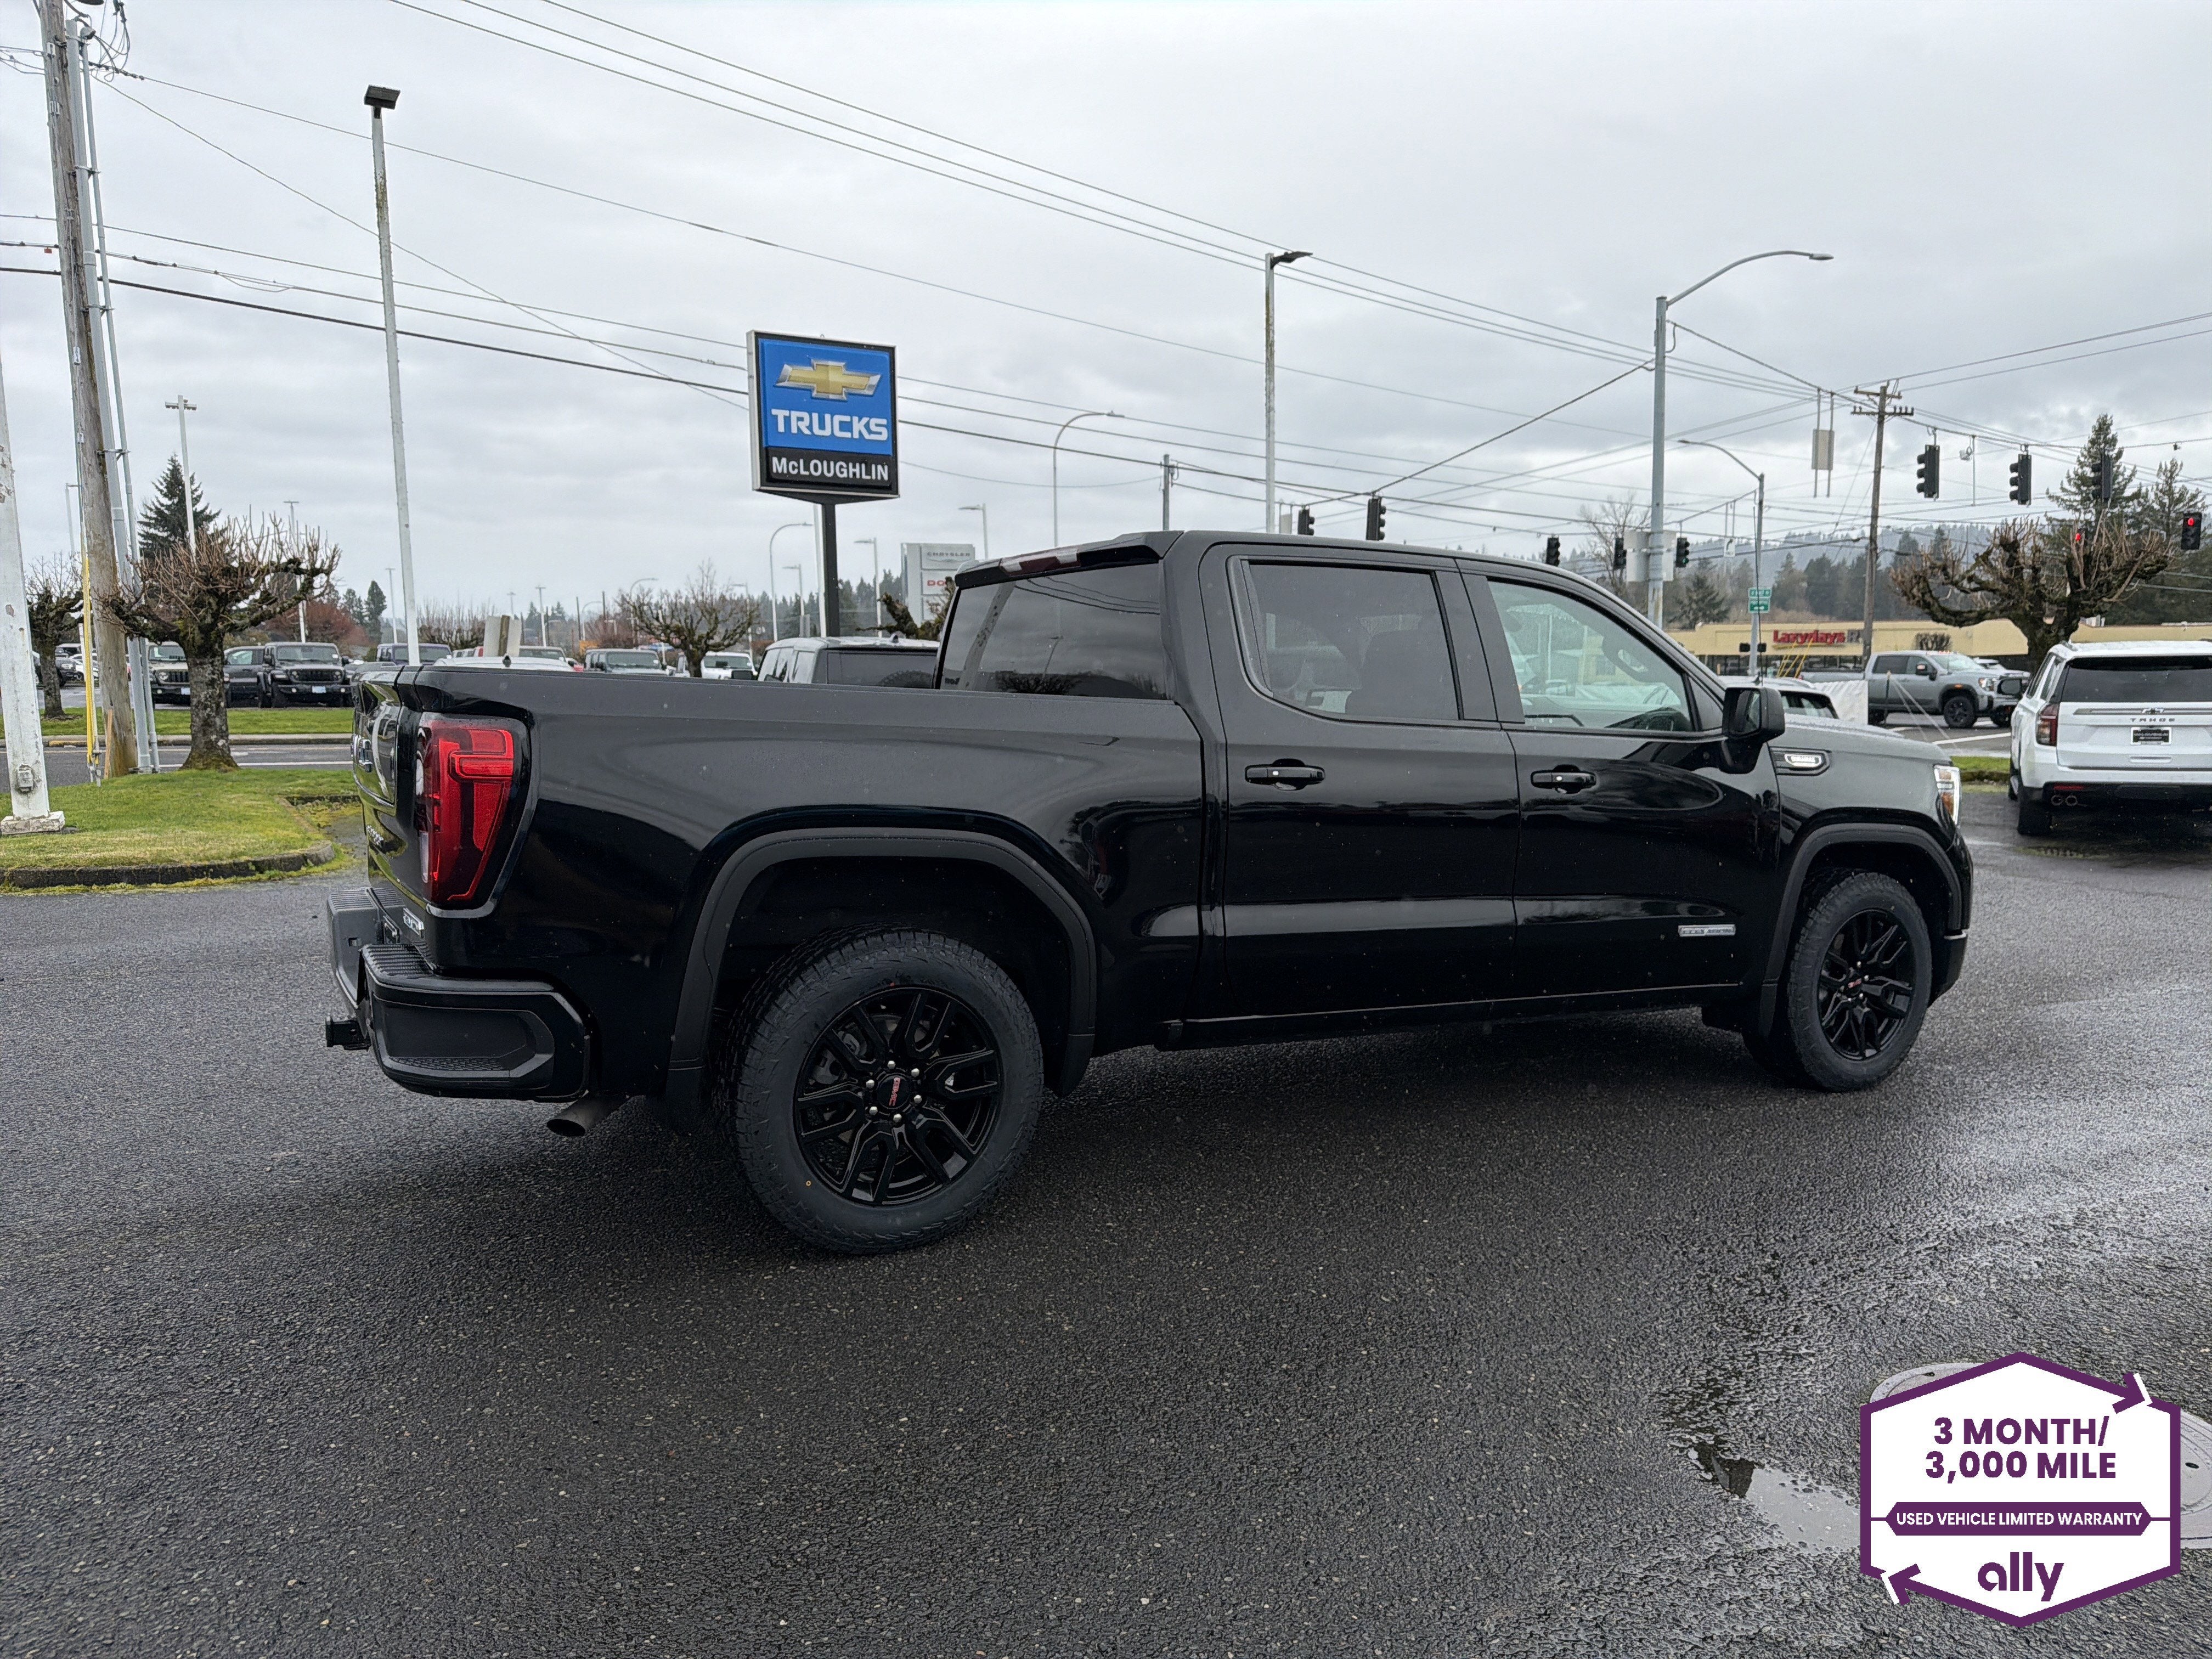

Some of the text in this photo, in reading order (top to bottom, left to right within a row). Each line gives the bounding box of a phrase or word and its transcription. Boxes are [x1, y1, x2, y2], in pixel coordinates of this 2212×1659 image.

[771, 409, 888, 441] TRUCKS
[772, 456, 888, 481] McLOUGHLIN
[1773, 629, 1846, 644] Lazydays
